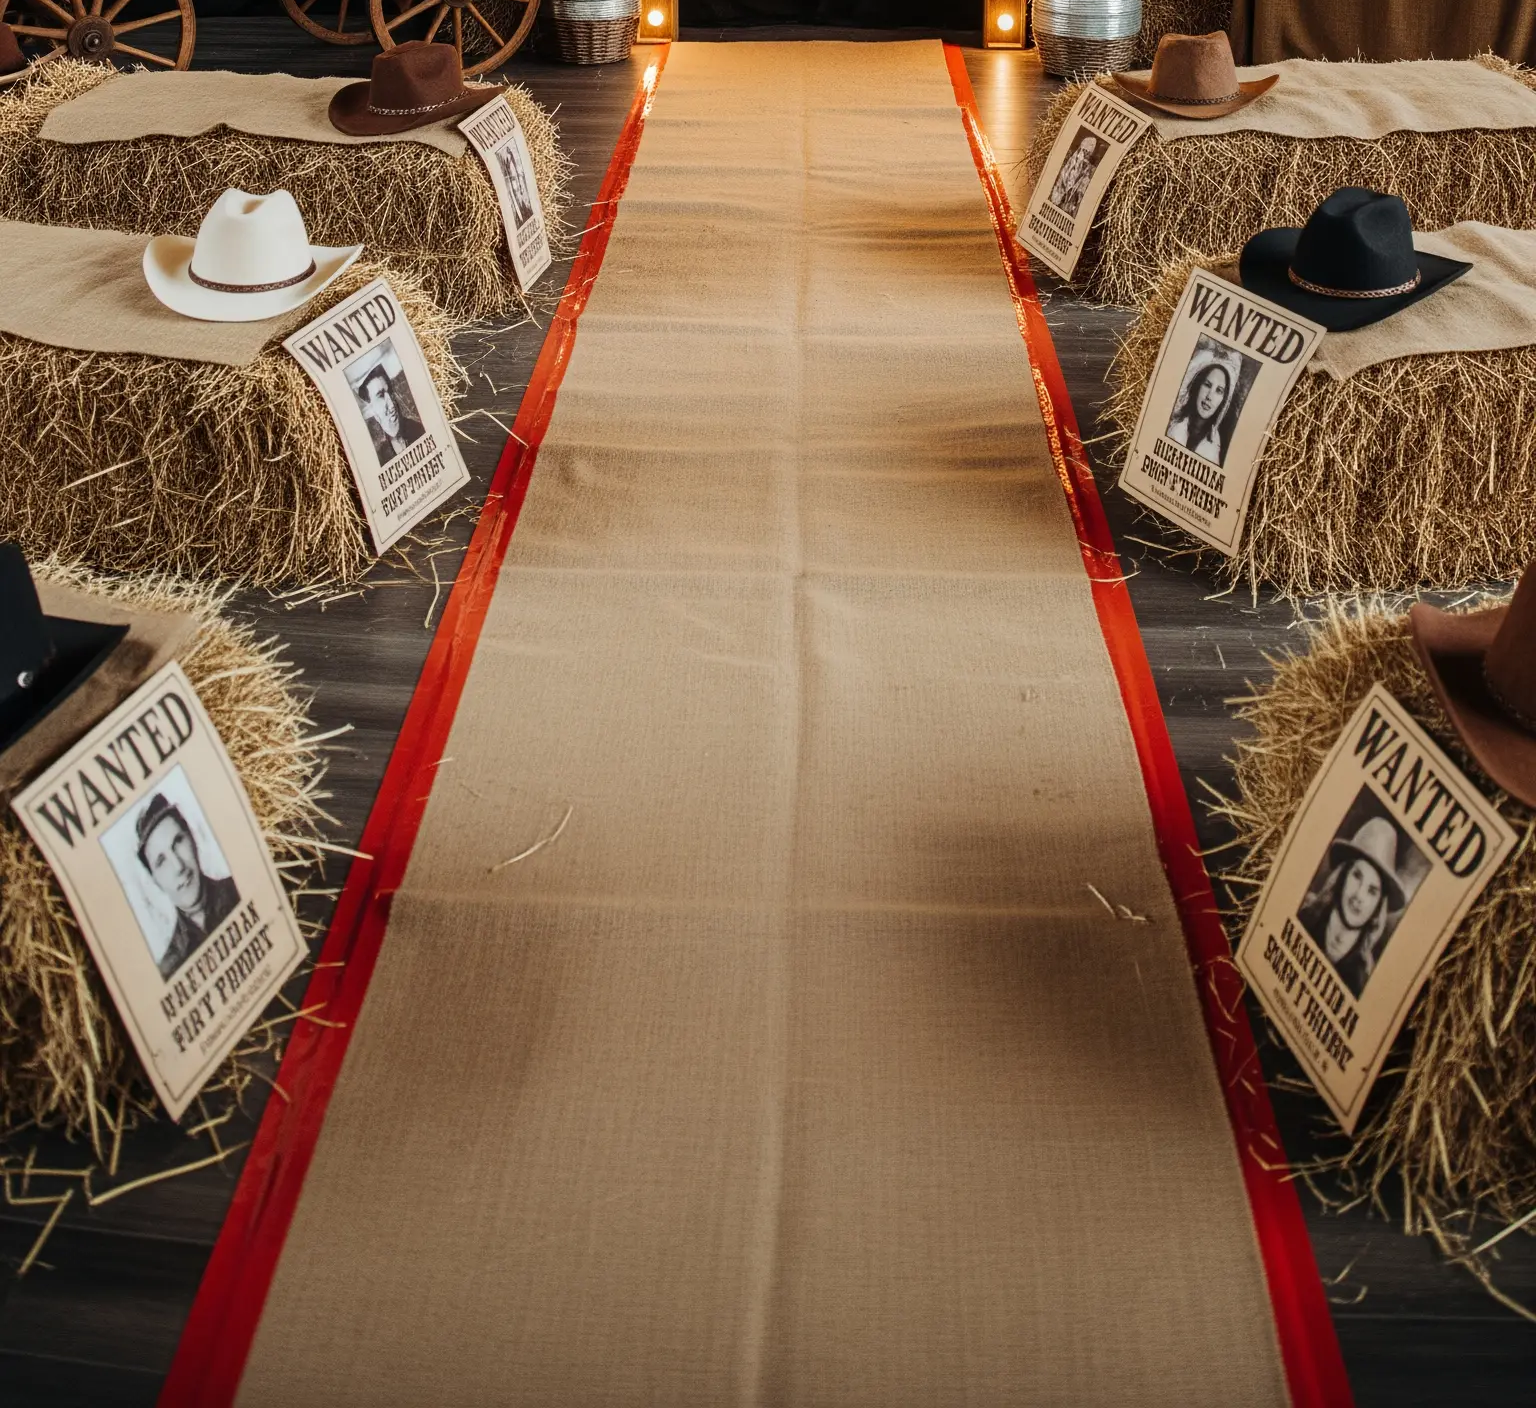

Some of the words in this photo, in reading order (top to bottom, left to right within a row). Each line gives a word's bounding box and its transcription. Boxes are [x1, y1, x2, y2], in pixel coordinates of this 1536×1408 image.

[1077, 92, 1138, 144] WANTED
[300, 294, 396, 373] WANTED
[1186, 282, 1304, 365] WANTED
[37, 691, 195, 848] WANTED
[1354, 708, 1487, 879] WANTED
